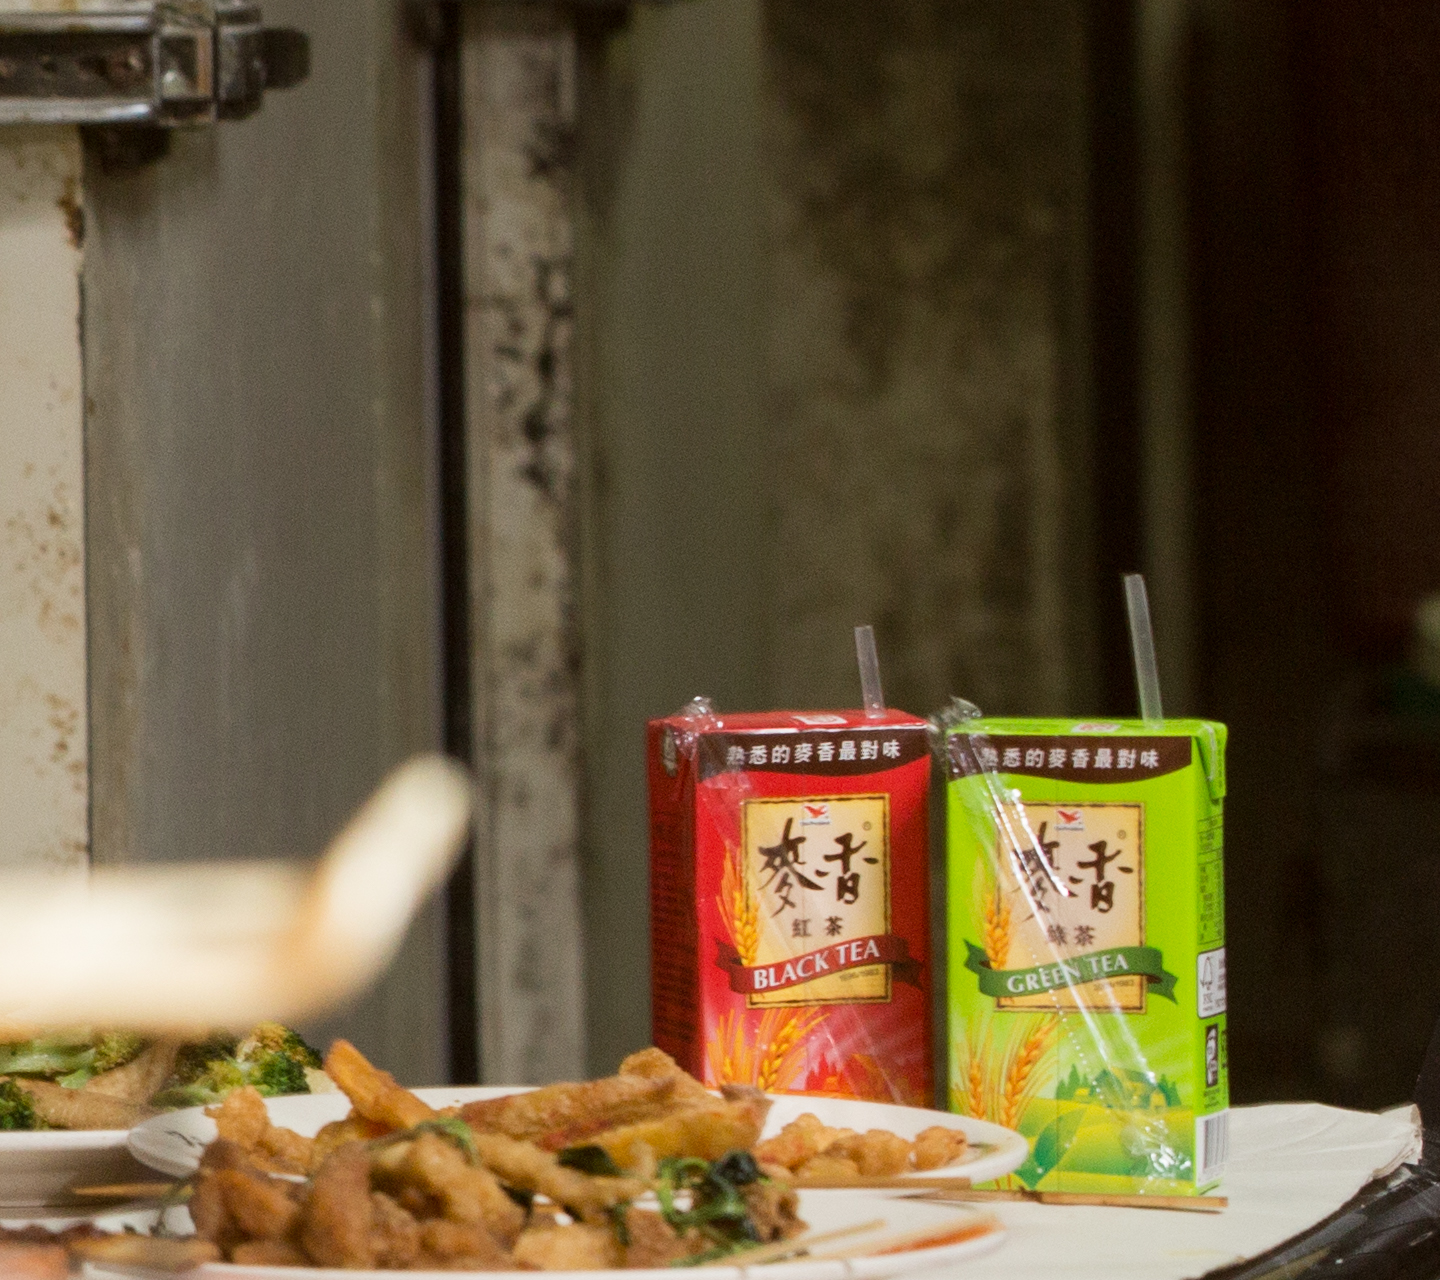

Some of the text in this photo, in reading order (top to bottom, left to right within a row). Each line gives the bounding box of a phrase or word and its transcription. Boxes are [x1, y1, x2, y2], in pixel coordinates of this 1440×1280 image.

[726, 738, 901, 766] 熟悉的麥香最對味
[980, 747, 1160, 769] 熟悉的麥香最對味
[758, 817, 879, 918] 麥香
[792, 917, 843, 938] 紅茶
[753, 939, 880, 990] BLACK TEA
[1006, 962, 1082, 994] GREEN
[1088, 953, 1130, 974] TEA
